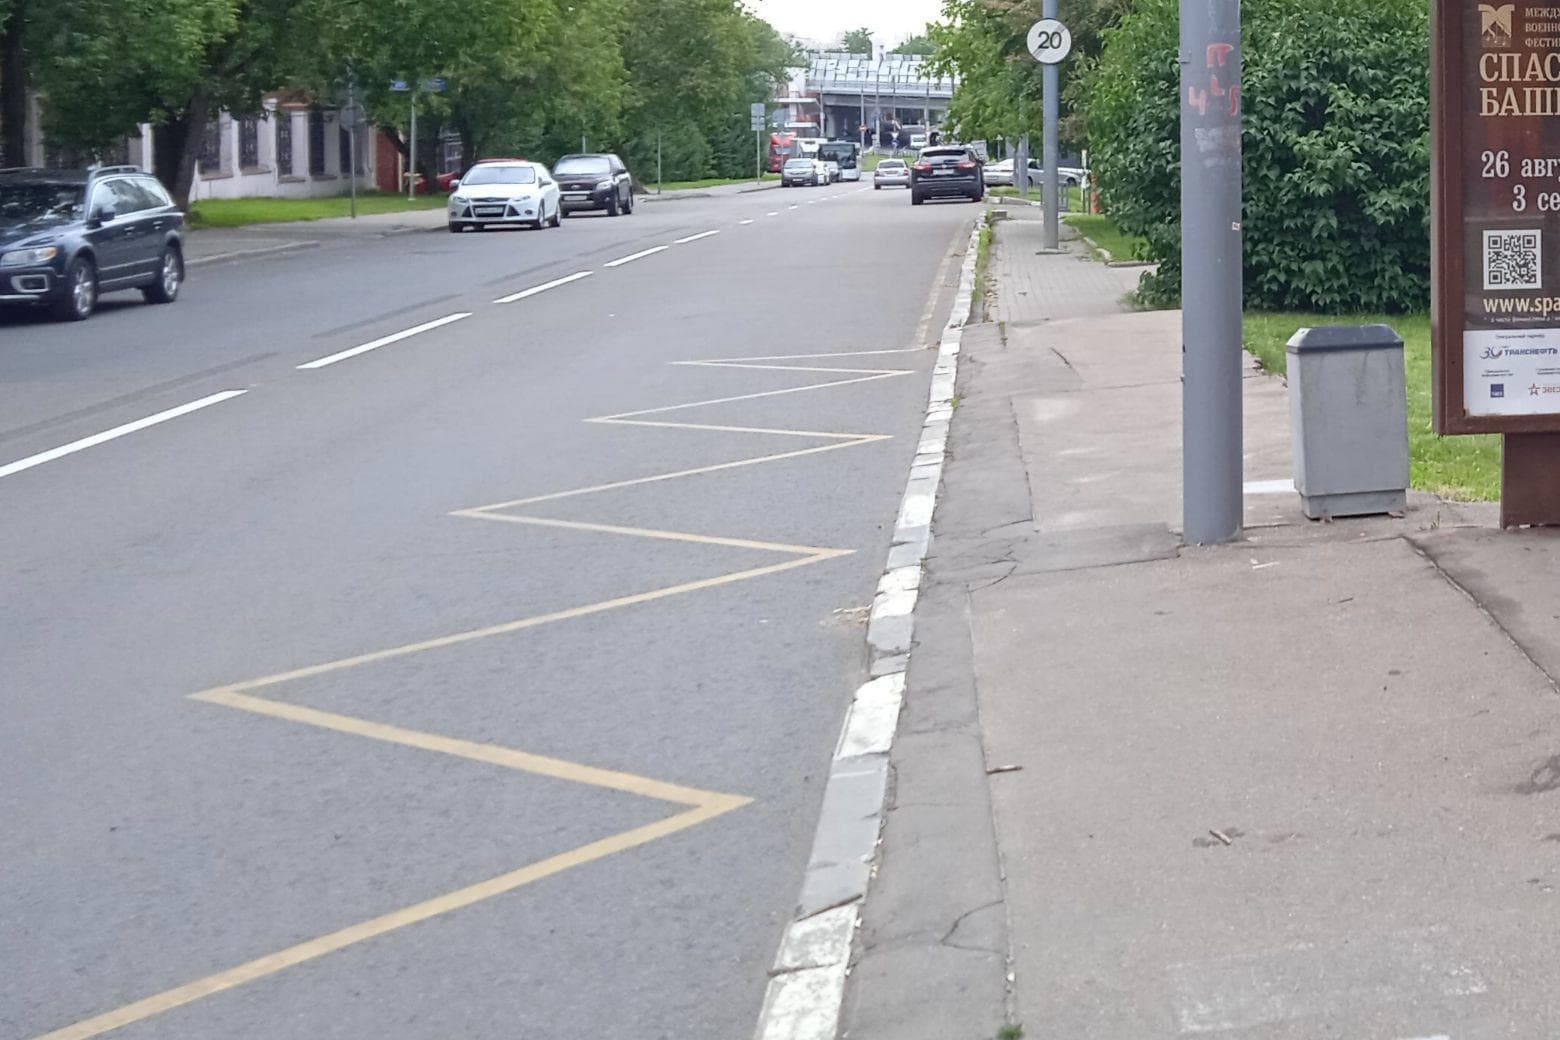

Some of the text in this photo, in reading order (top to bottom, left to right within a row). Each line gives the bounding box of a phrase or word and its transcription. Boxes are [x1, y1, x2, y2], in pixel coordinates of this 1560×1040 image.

[1038, 31, 1062, 49] 20
[1481, 150, 1510, 178] 26
[1512, 184, 1526, 212] 3
[1504, 347, 1558, 356] ТРАНСНЕФТЬ
